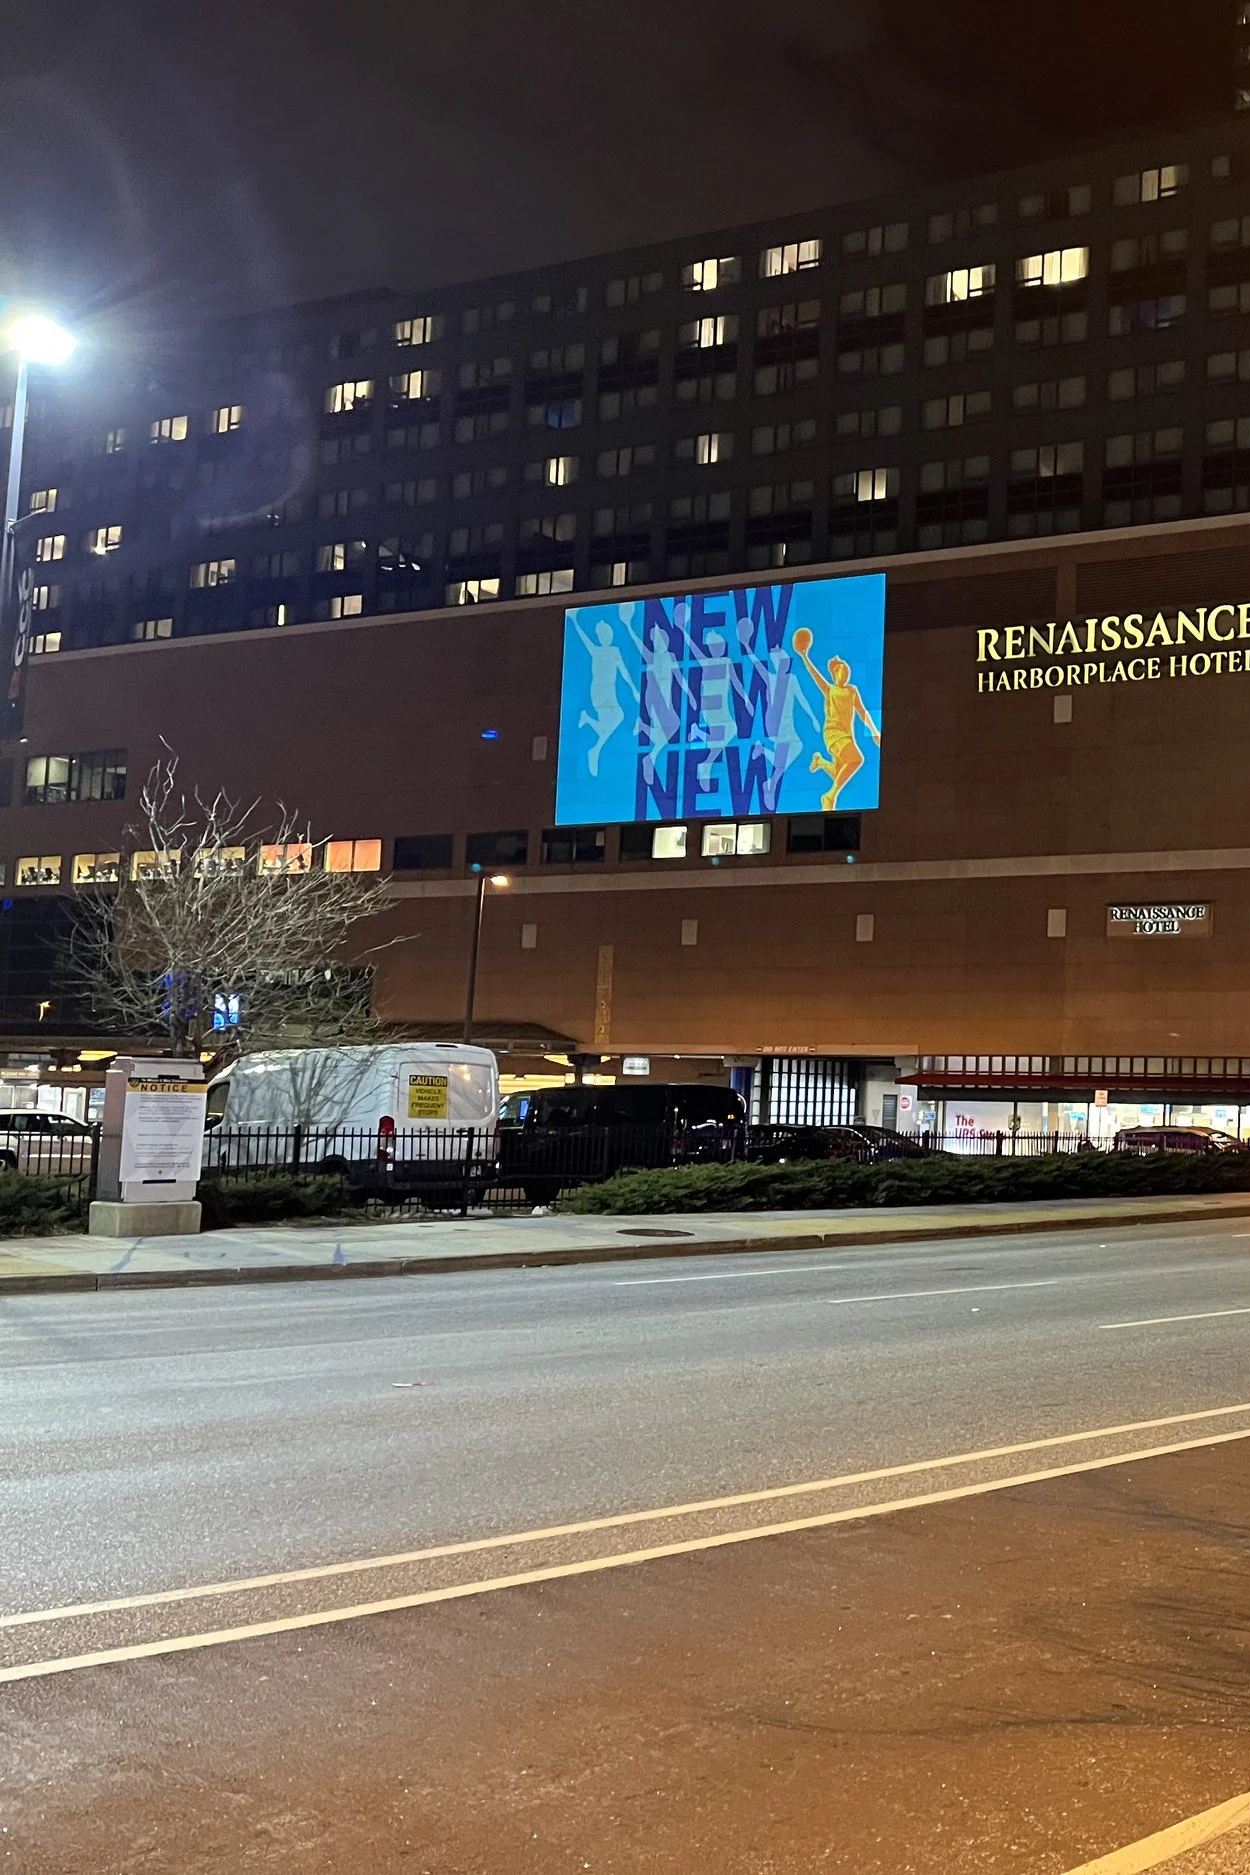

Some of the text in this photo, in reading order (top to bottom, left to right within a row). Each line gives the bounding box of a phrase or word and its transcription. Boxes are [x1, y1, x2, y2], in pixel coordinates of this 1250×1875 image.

[642, 584, 794, 664] NEW
[978, 657, 1161, 693] HARBORPLACE
[638, 657, 793, 747] NEW
[634, 742, 791, 821] NEW
[1109, 906, 1206, 922] RENAISSANCE
[1133, 920, 1182, 935] HOTEL
[140, 1083, 188, 1093] NOTICE
[410, 1075, 447, 1086] CAUTION
[955, 1114, 975, 1127] The
